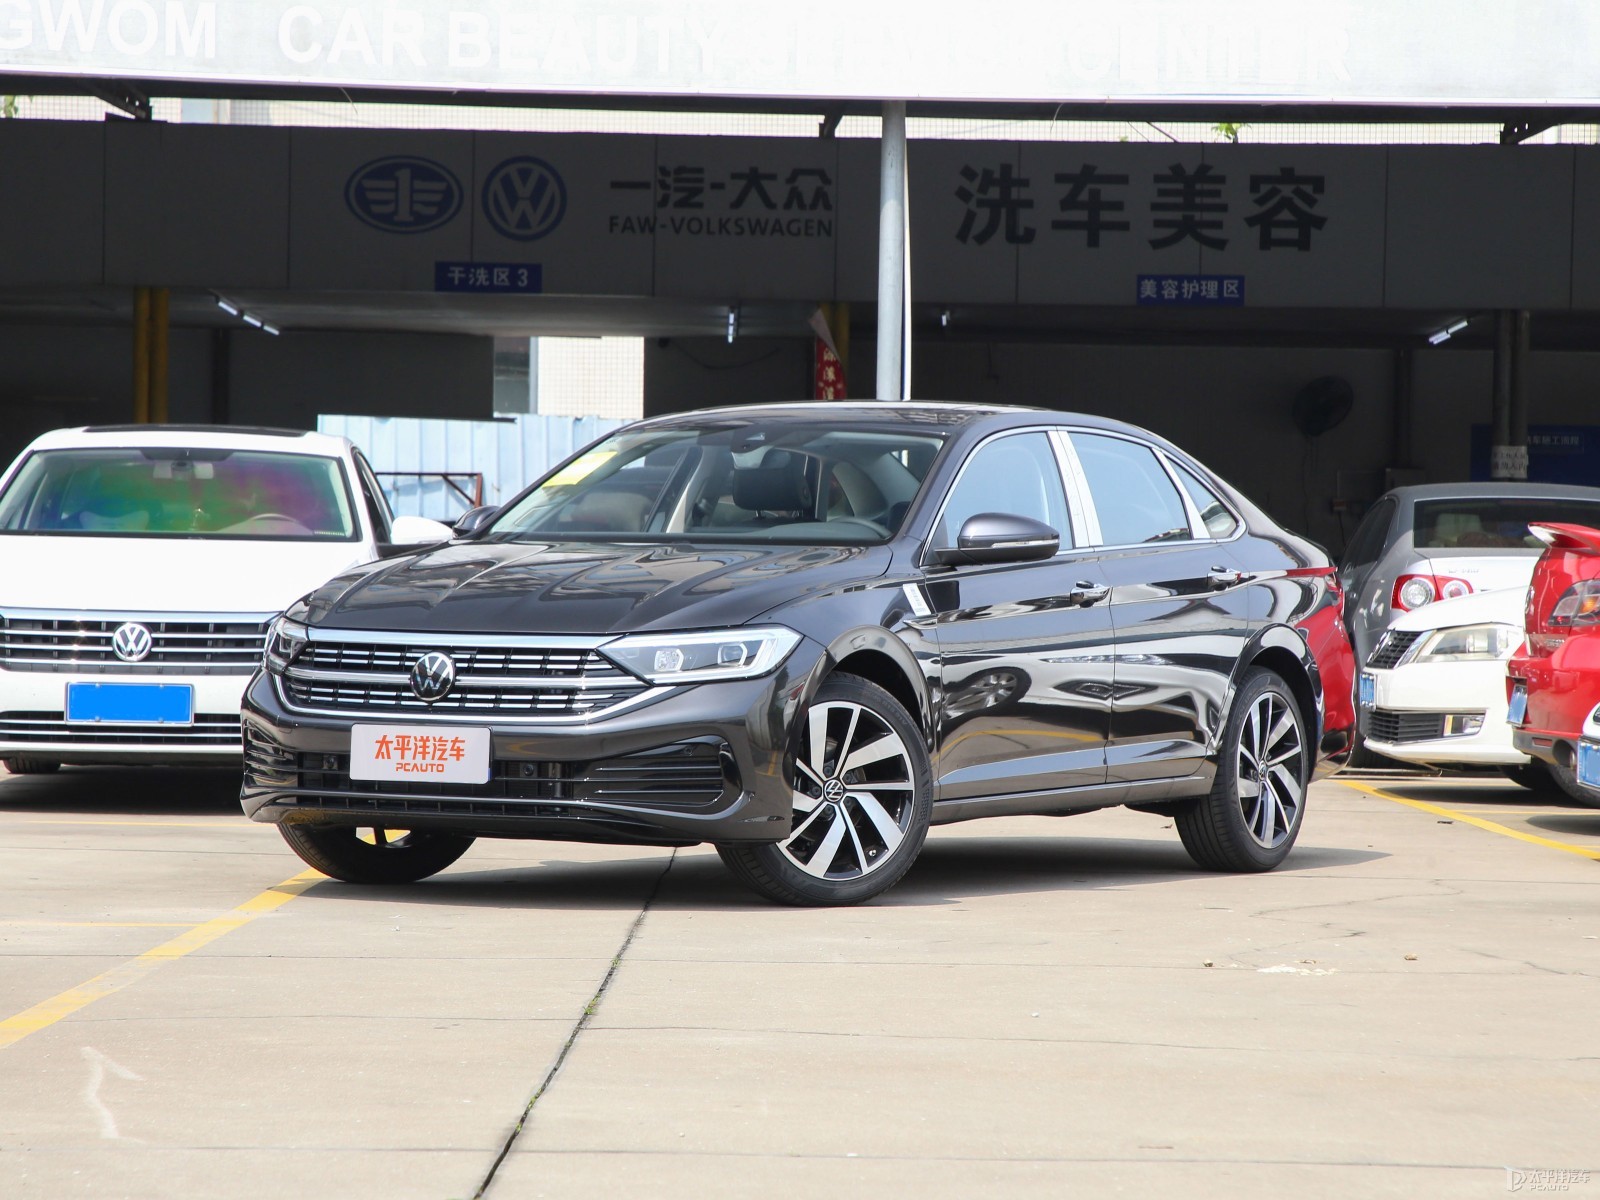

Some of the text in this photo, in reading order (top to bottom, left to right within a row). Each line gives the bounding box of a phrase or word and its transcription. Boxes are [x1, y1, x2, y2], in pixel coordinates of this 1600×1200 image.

[277, 4, 427, 66] CAR
[447, 11, 722, 74] BEAUTY
[609, 165, 833, 211] 一汽-大众
[954, 162, 1329, 251] 洗车美容
[608, 215, 833, 237] FAW-VOLKSWAGEN
[447, 266, 528, 288] 干洗区 3
[1139, 278, 1241, 300] 美容护理区
[374, 734, 466, 761] 太平洋汽车
[395, 762, 445, 773] PCAUTO
